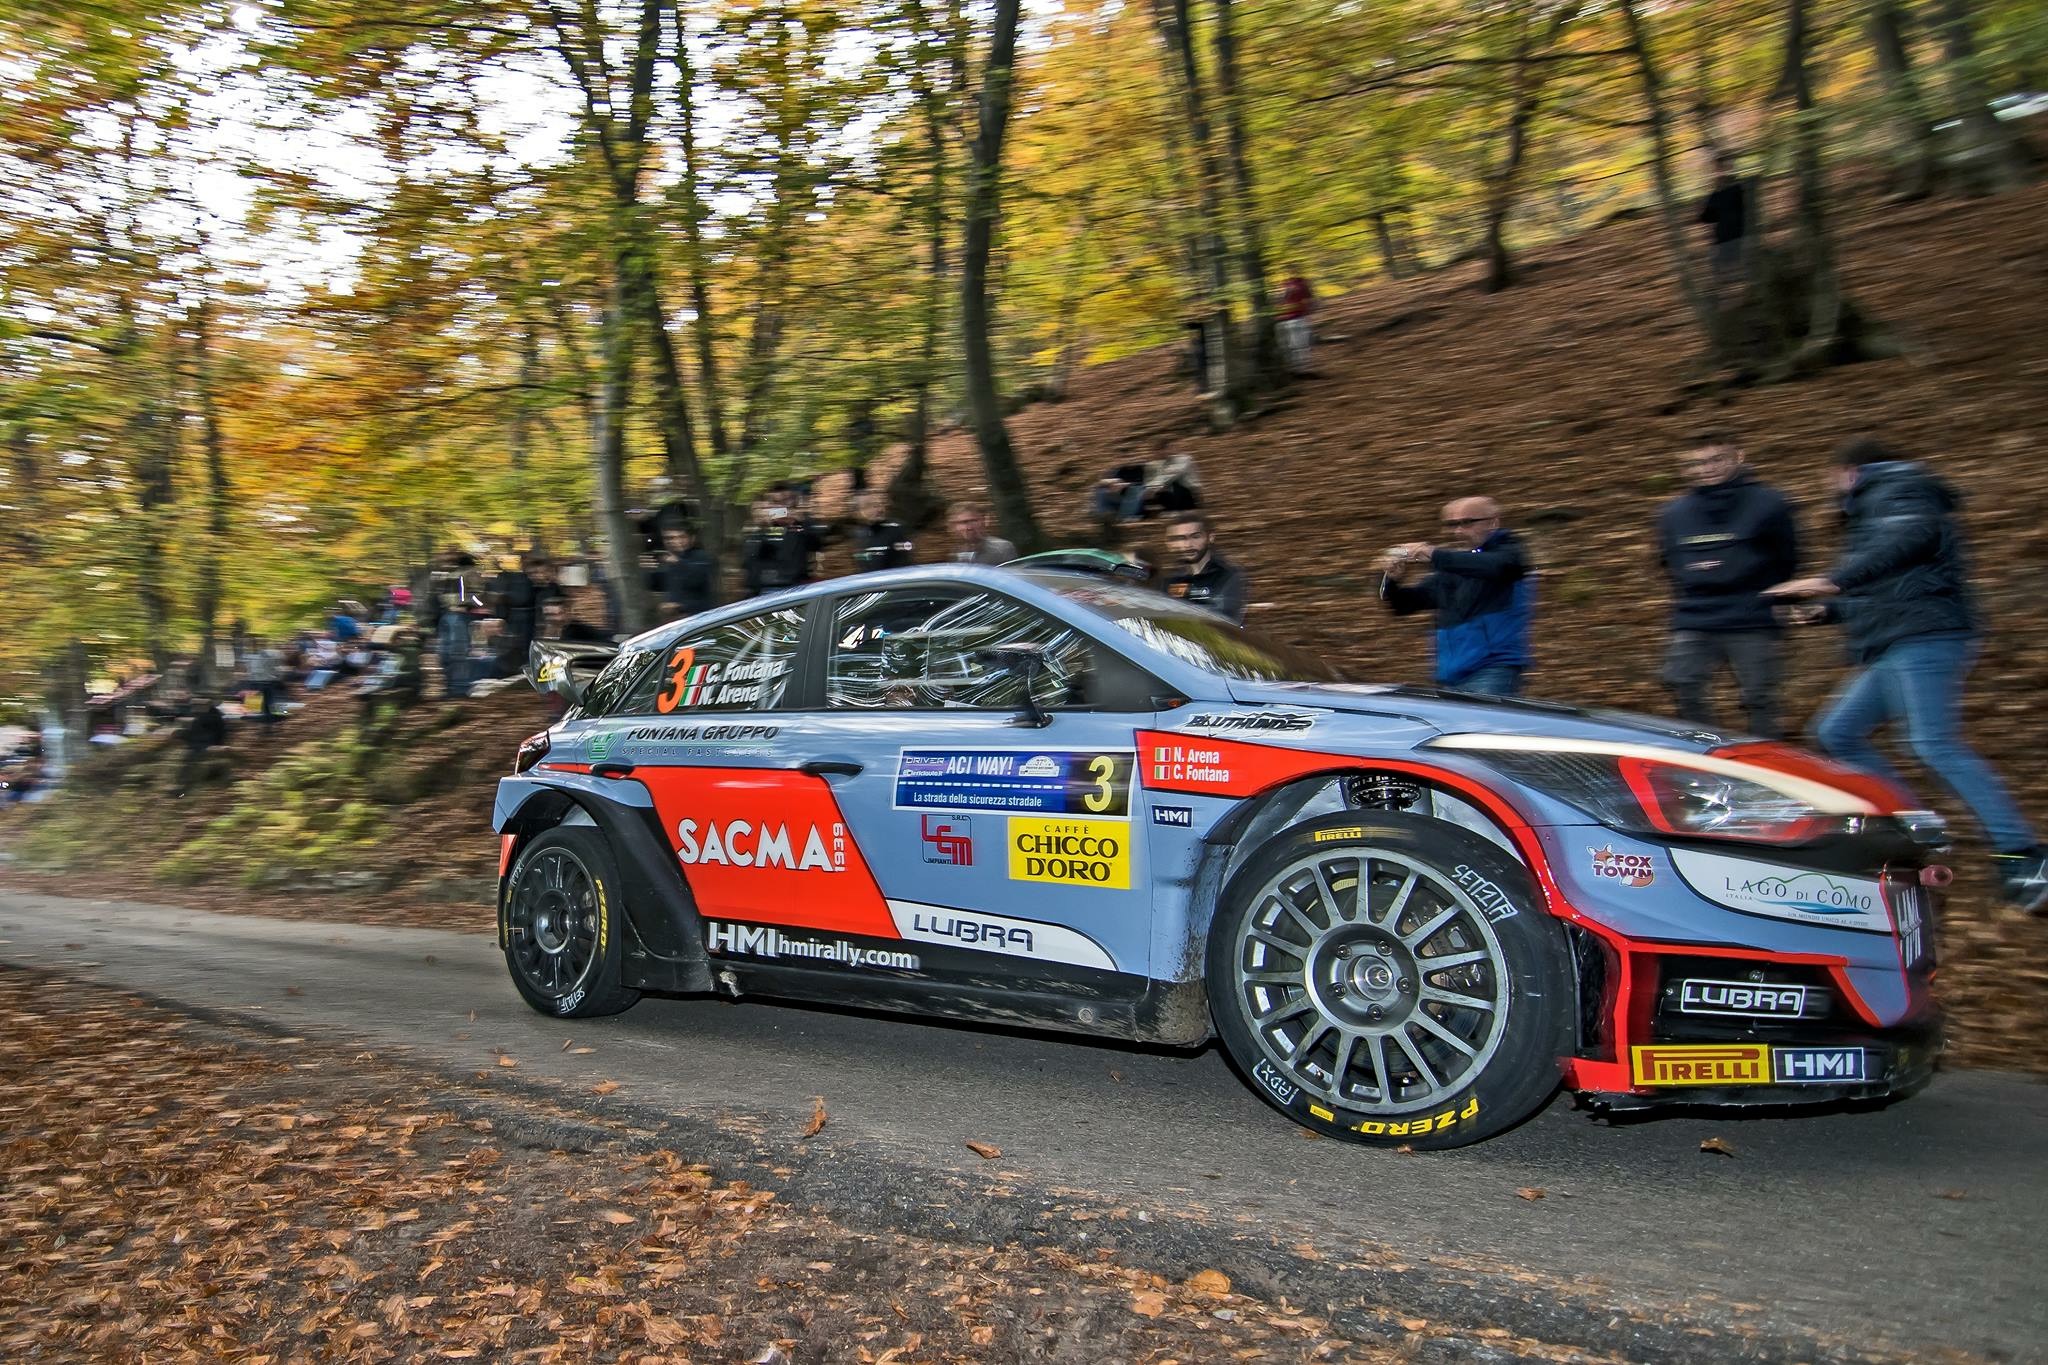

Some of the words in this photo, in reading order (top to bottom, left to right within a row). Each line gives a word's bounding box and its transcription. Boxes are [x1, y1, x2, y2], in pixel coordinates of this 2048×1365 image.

[657, 647, 696, 714] 3
[706, 662, 721, 683] C.
[722, 660, 787, 682] Fontana
[698, 685, 715, 706] N.
[715, 685, 760, 705] Arena
[626, 726, 699, 741] FONTANA
[701, 726, 781, 741] GRUPPO
[622, 747, 677, 756] SPECIAL
[1173, 747, 1185, 763] N.
[1187, 749, 1220, 764] Arena
[946, 756, 973, 775] ACI
[976, 757, 1014, 776] WAY!
[1173, 764, 1183, 780] C.
[1186, 765, 1230, 783] Fontana
[1083, 755, 1115, 813] 3
[913, 792, 923, 802] La
[924, 792, 947, 803] strada
[949, 793, 967, 804] della
[969, 794, 1006, 806] sicurezza
[1008, 795, 1042, 807] stradale
[1154, 809, 1189, 824] HMI
[1044, 824, 1089, 834] CAFFÈ
[1314, 826, 1362, 842] PIRELLI
[677, 818, 834, 872] SACMA
[832, 822, 846, 872] 1939
[1016, 833, 1119, 859] CHICCO
[1026, 857, 1111, 882] D'ORO
[1593, 864, 1652, 878] TOWN
[1614, 854, 1652, 868] FOX
[1725, 877, 1787, 898] LAGO
[1796, 891, 1808, 901] DI
[1817, 889, 1871, 910] COMO
[709, 921, 777, 958] HMI
[779, 933, 914, 967] hmirally.com
[913, 913, 1034, 952] LUBRA
[1684, 985, 1801, 1011] LUBRA
[1641, 1047, 1760, 1081] PIRELLI
[1783, 1053, 1854, 1076] HMI
